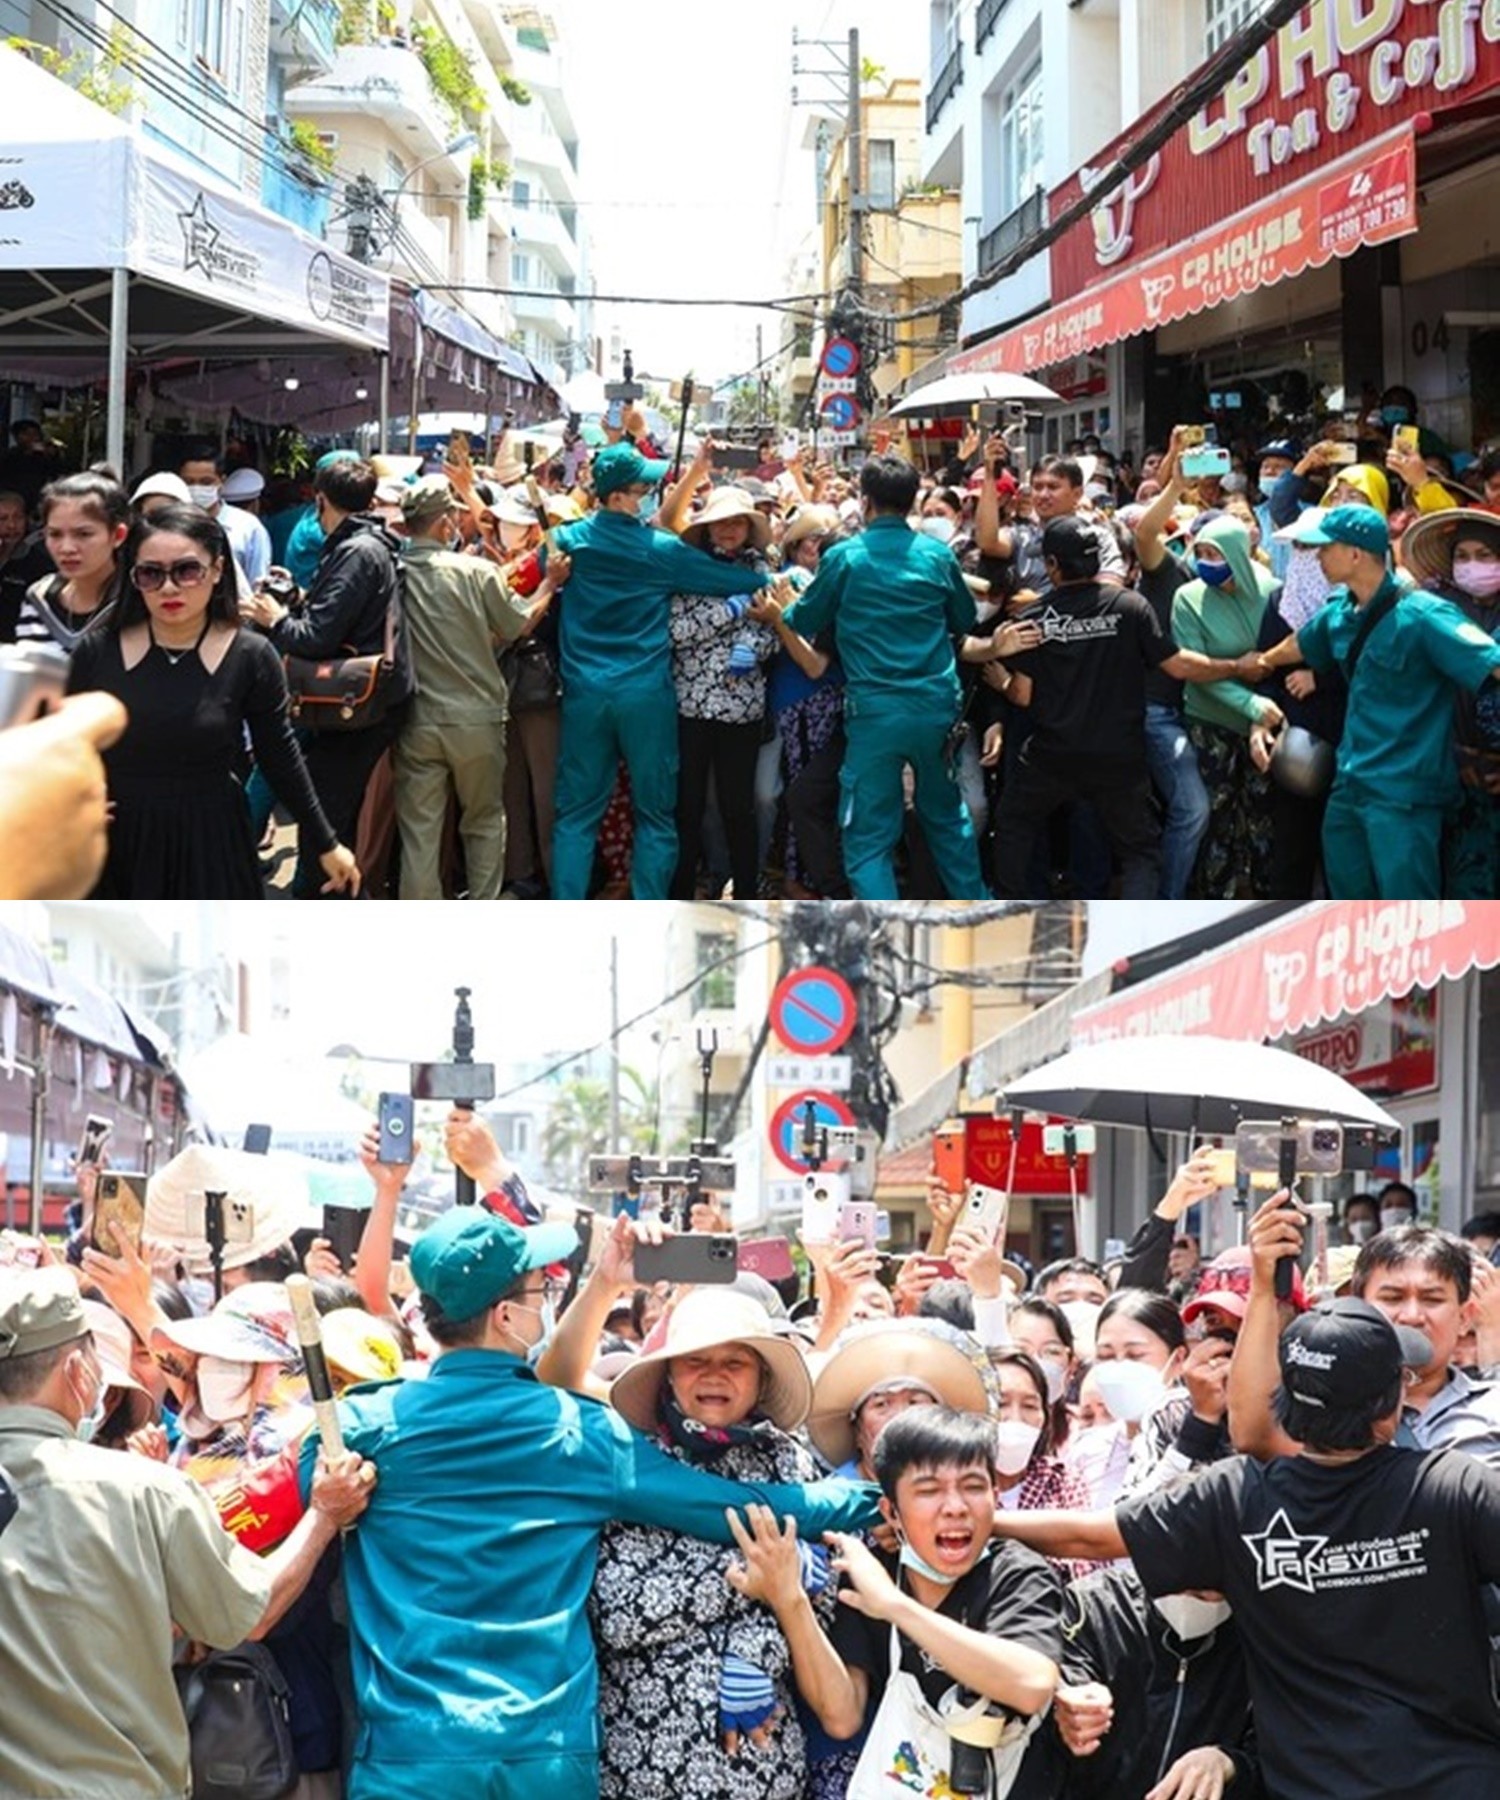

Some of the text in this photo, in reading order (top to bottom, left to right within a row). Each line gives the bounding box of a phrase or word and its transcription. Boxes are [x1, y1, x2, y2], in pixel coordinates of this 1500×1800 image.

[1247, 109, 1319, 176] Tea
[1327, 72, 1361, 133] &
[1347, 172, 1373, 198] 4
[1182, 207, 1303, 290] CP HOUSE
[1316, 900, 1465, 979] CP HOUSE
[1265, 1538, 1423, 1577] FANSVIET
